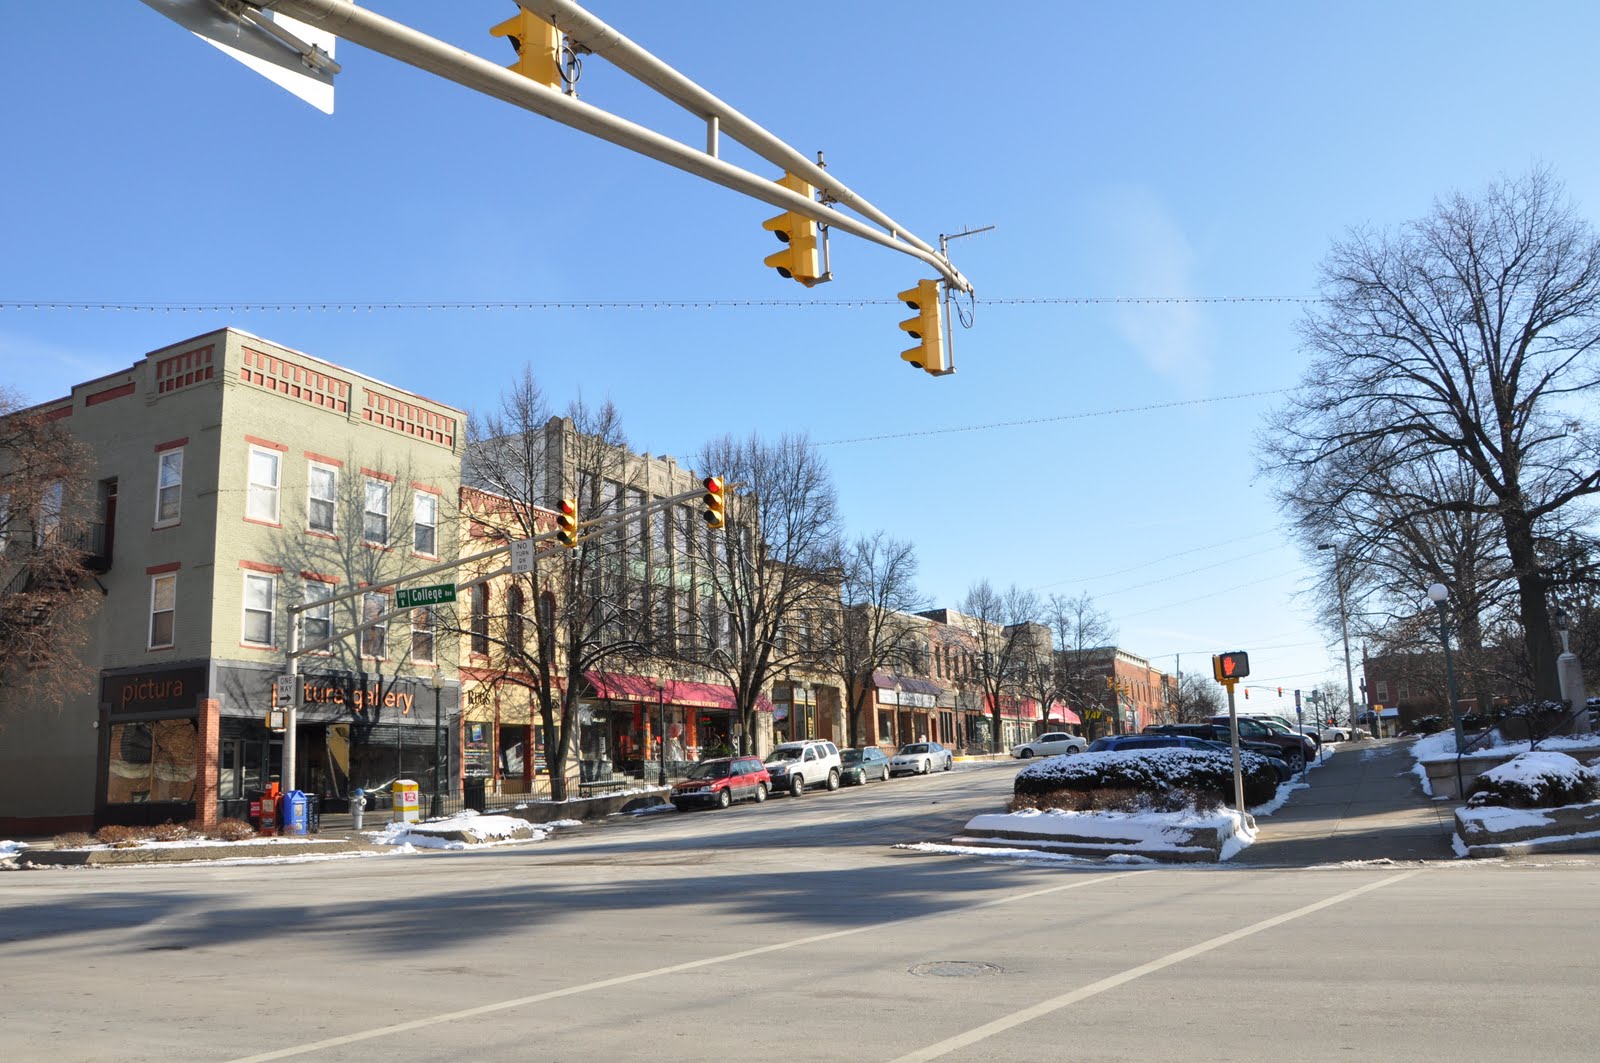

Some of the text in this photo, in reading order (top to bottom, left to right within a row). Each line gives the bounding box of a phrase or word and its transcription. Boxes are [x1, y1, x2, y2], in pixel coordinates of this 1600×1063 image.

[412, 588, 443, 603] College
[280, 676, 293, 685] ONE
[122, 677, 183, 712] pictura
